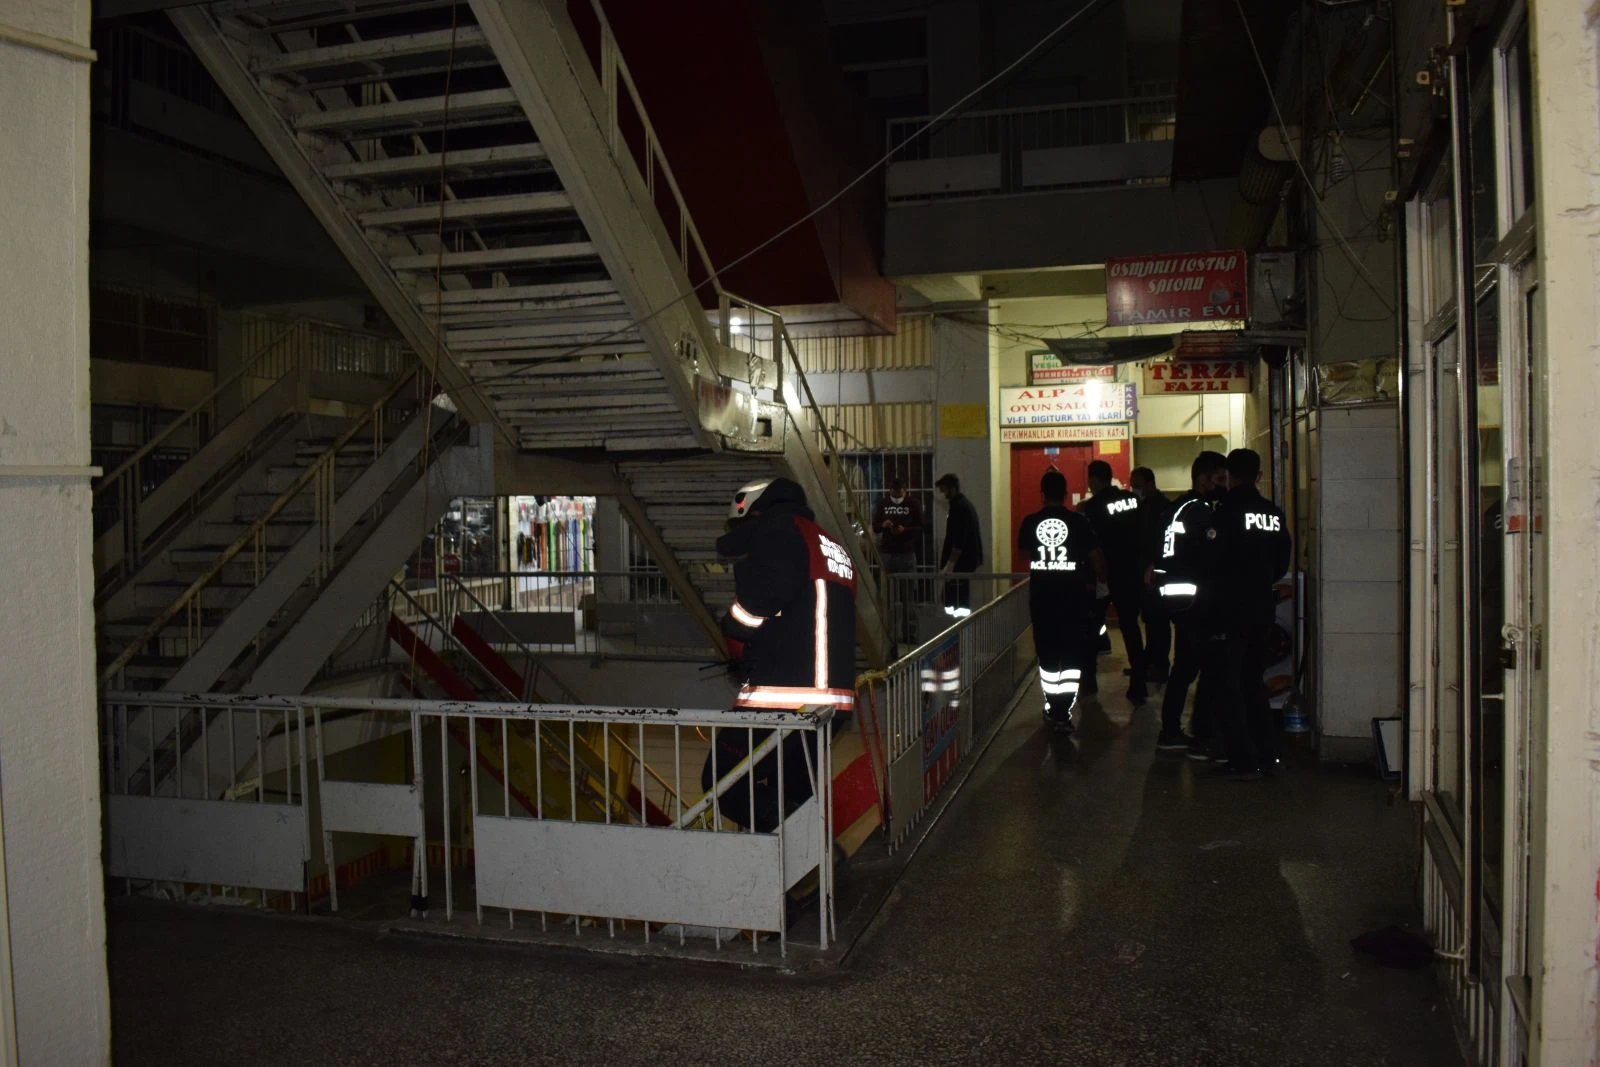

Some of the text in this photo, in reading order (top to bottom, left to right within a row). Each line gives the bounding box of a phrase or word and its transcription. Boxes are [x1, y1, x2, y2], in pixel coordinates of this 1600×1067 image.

[1111, 256, 1237, 278] OSMANLI LOSTRA
[1147, 276, 1205, 295] SALONU
[1114, 301, 1240, 322] TAMİR EVİ
[1151, 360, 1247, 380] TERZİ
[1018, 388, 1065, 400] ALP
[1164, 381, 1229, 392] FAZLI
[1010, 403, 1052, 413] OYUN
[1125, 386, 1134, 417] KAT 6
[1007, 416, 1027, 425] VI-FI
[1037, 545, 1068, 561] 112
